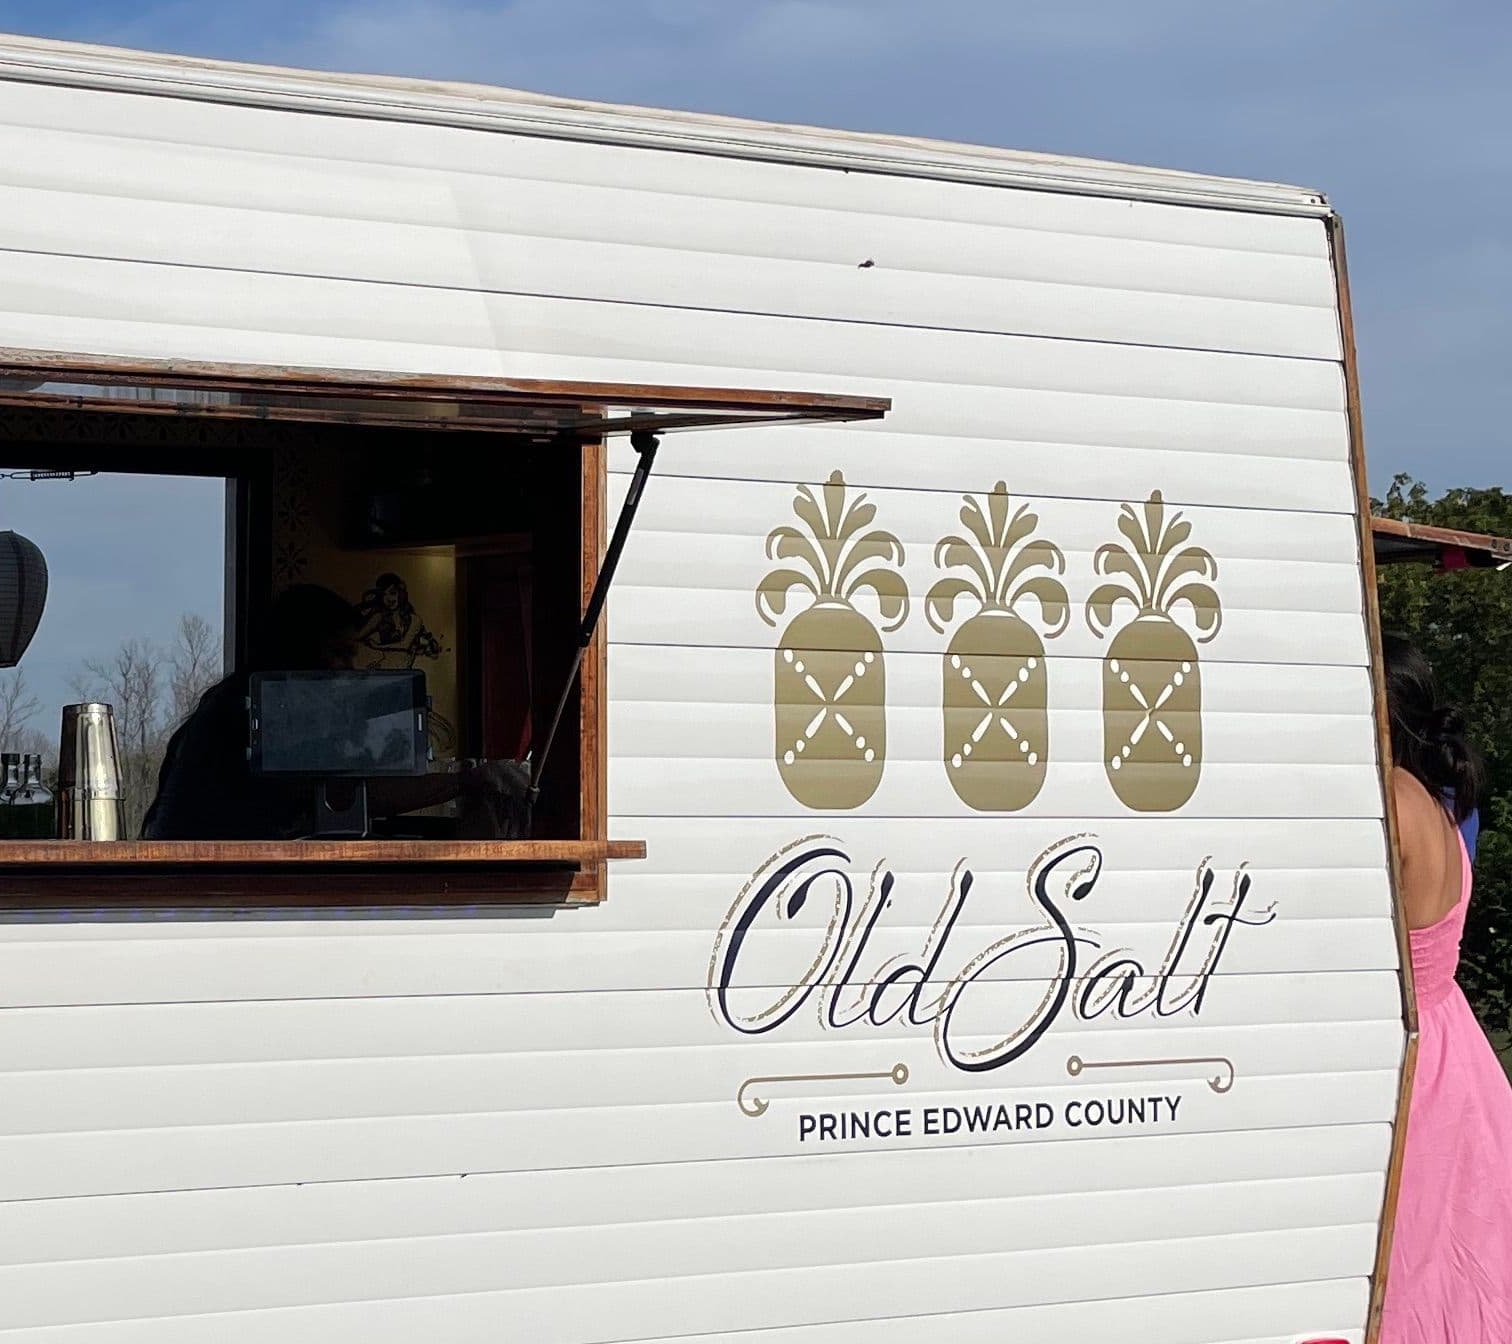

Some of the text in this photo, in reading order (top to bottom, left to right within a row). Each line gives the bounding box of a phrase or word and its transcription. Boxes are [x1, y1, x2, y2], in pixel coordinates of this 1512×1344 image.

[707, 832, 1278, 1072] Old Salt
[798, 1095, 1183, 1143] PRINCE EDWARD COUNTY
